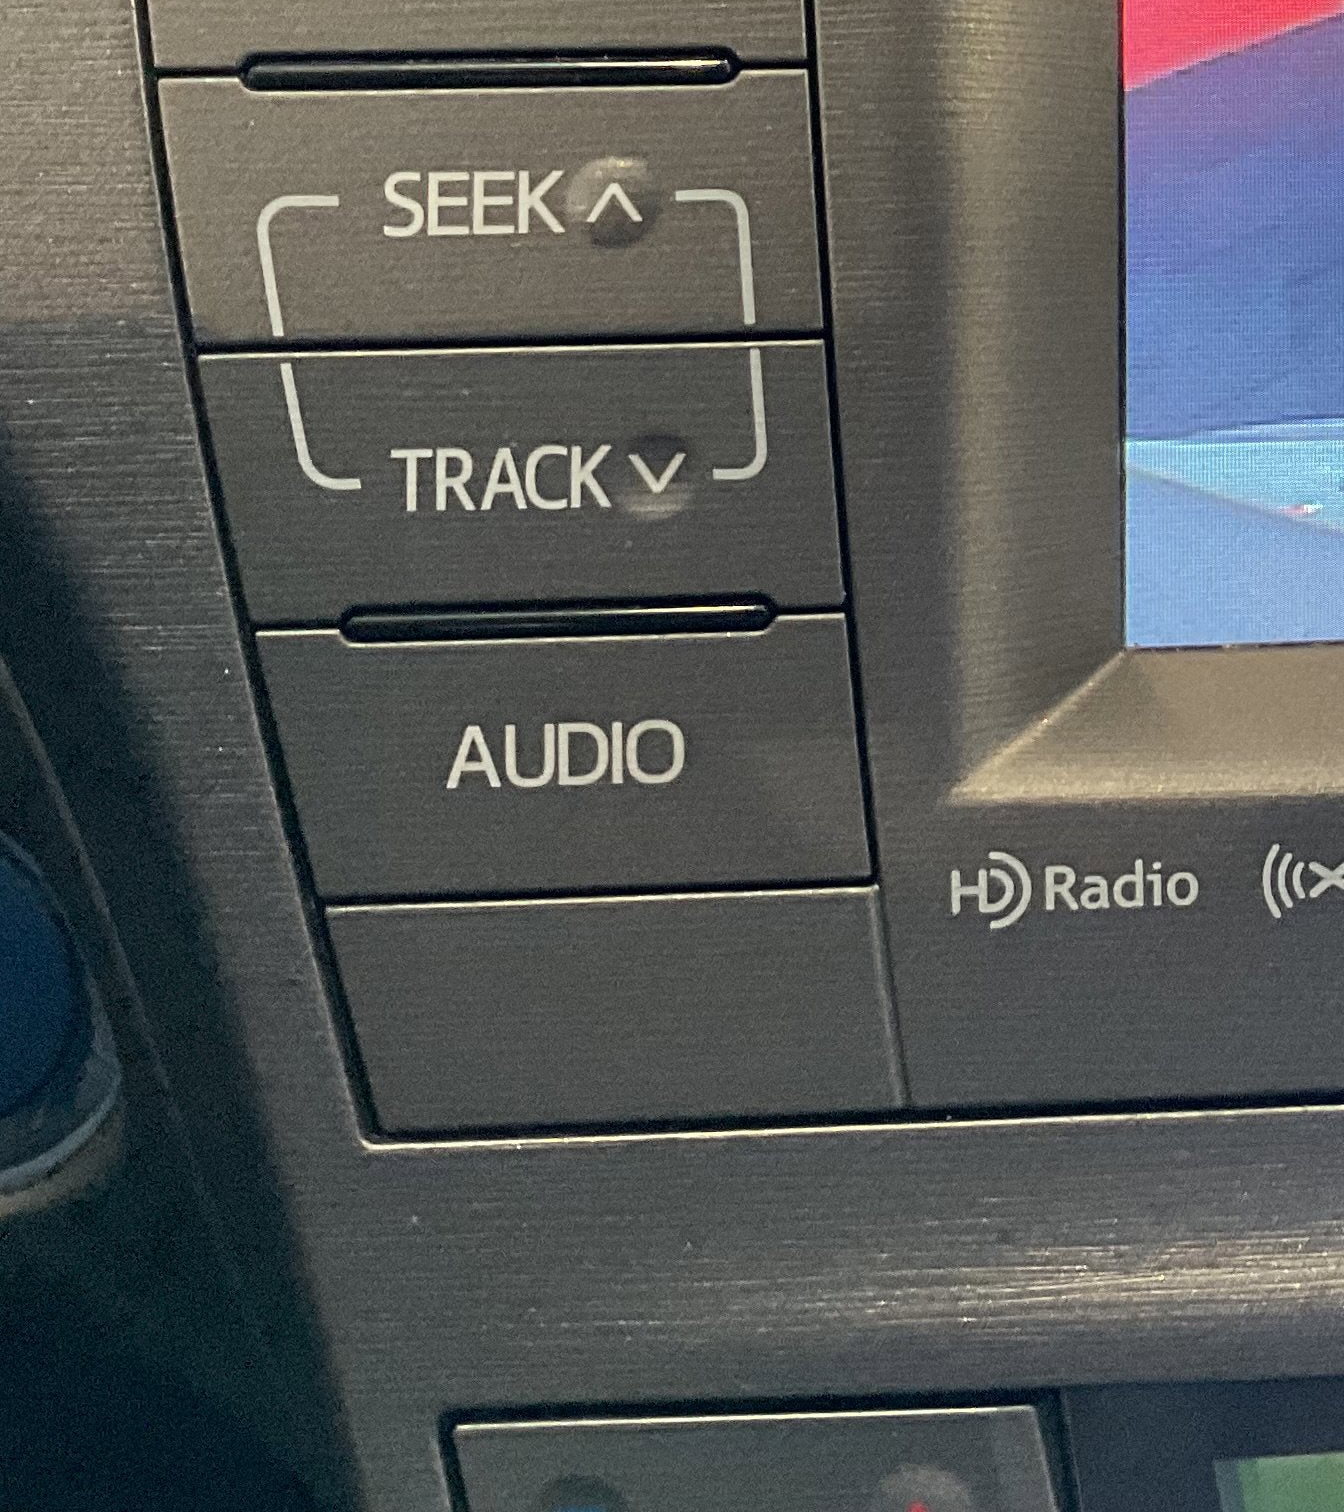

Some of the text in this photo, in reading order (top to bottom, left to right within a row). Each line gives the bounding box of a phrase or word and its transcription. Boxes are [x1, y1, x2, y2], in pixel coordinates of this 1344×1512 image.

[382, 169, 565, 237] SEEK
[390, 443, 612, 512] TRACK
[446, 719, 686, 789] AUDIO
[1045, 859, 1200, 911] Radio
